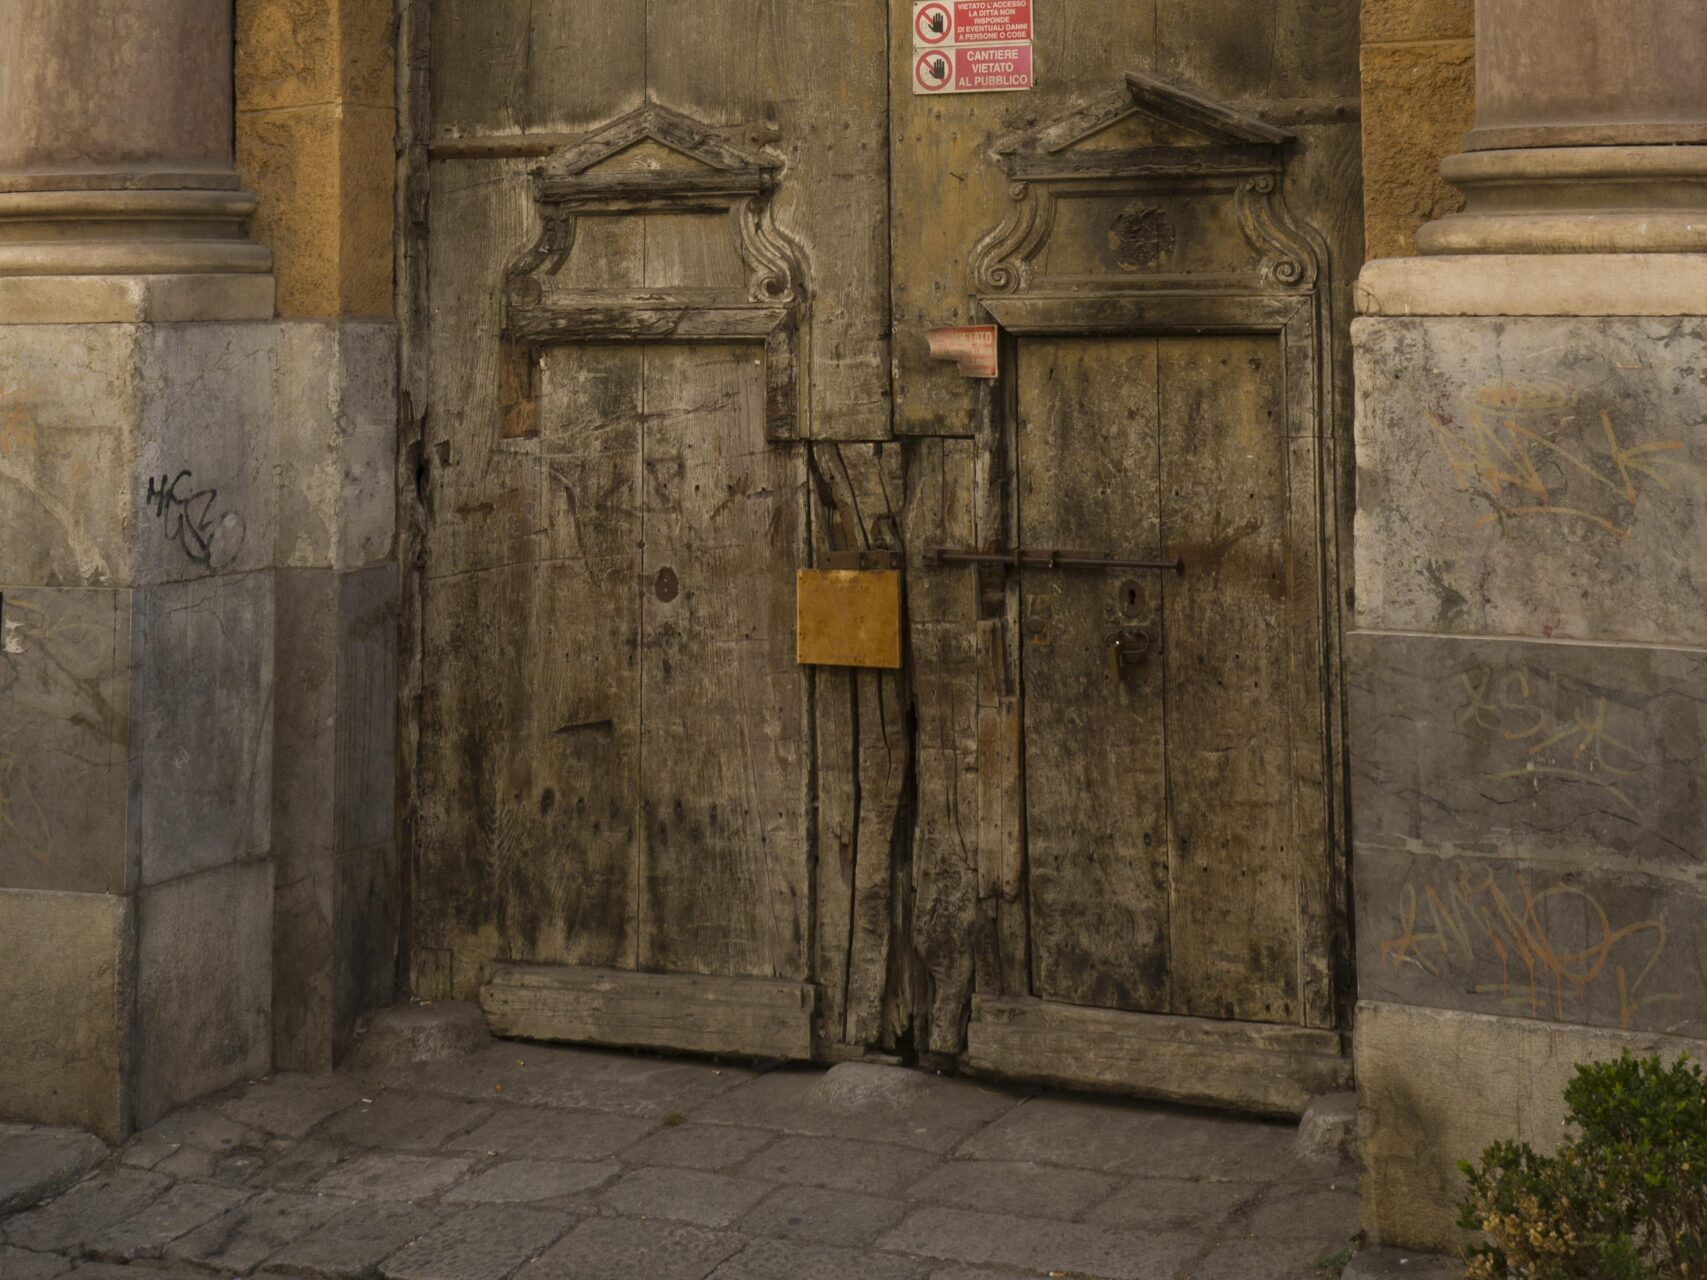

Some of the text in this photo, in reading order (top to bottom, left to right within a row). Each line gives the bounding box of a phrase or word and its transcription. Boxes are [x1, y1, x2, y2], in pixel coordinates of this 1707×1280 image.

[957, 0, 1026, 10] VIETATO L'ACCESSO
[979, 9, 998, 17] DITTA
[1000, 8, 1015, 16] NON
[974, 16, 1009, 24] RISPONDE
[966, 24, 1004, 33] EVENTUALI
[1005, 23, 1027, 31] DANNI
[965, 32, 998, 40] PERSONE
[999, 31, 1005, 39] O
[1006, 30, 1027, 38] COSE
[966, 49, 1019, 61] CANTIERE
[972, 62, 1014, 73] VIETATO
[958, 74, 1028, 87] AL PUBBLICO
